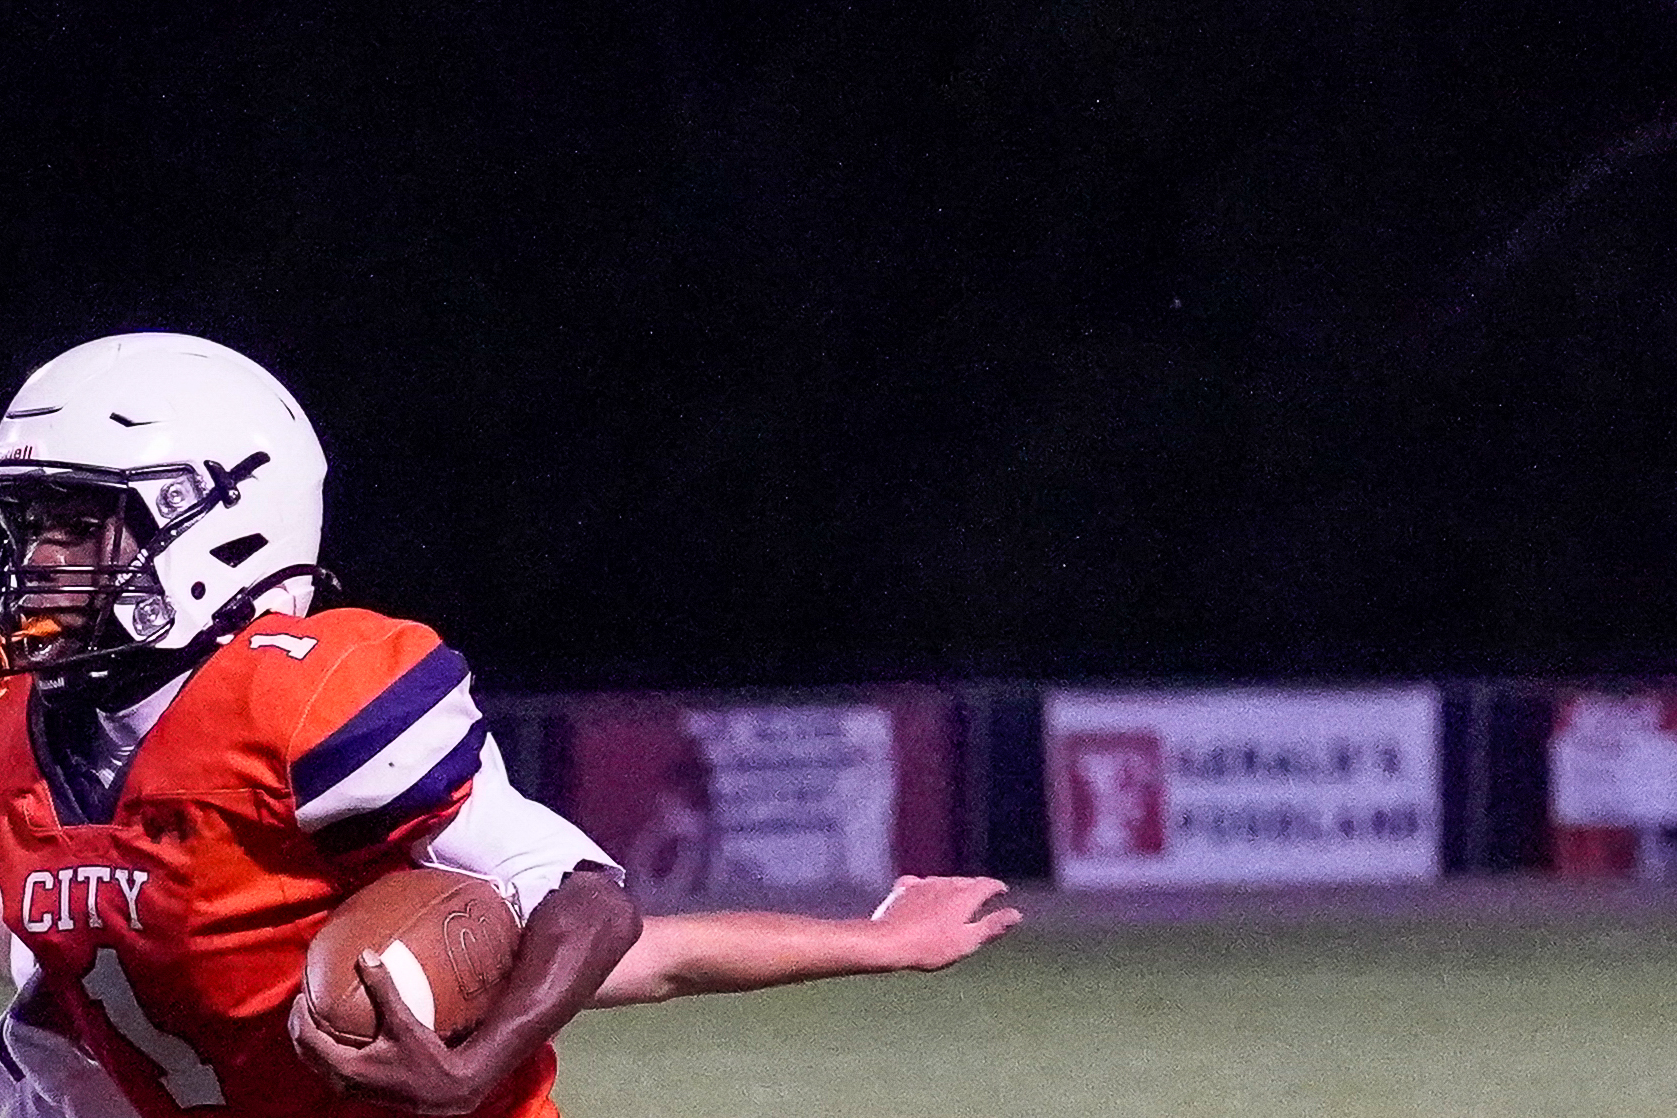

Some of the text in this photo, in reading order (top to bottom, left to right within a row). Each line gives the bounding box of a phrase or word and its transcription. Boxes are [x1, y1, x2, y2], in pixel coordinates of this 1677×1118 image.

[249, 633, 319, 661] 1
[22, 865, 149, 933] CITY
[81, 947, 227, 1109] 1
